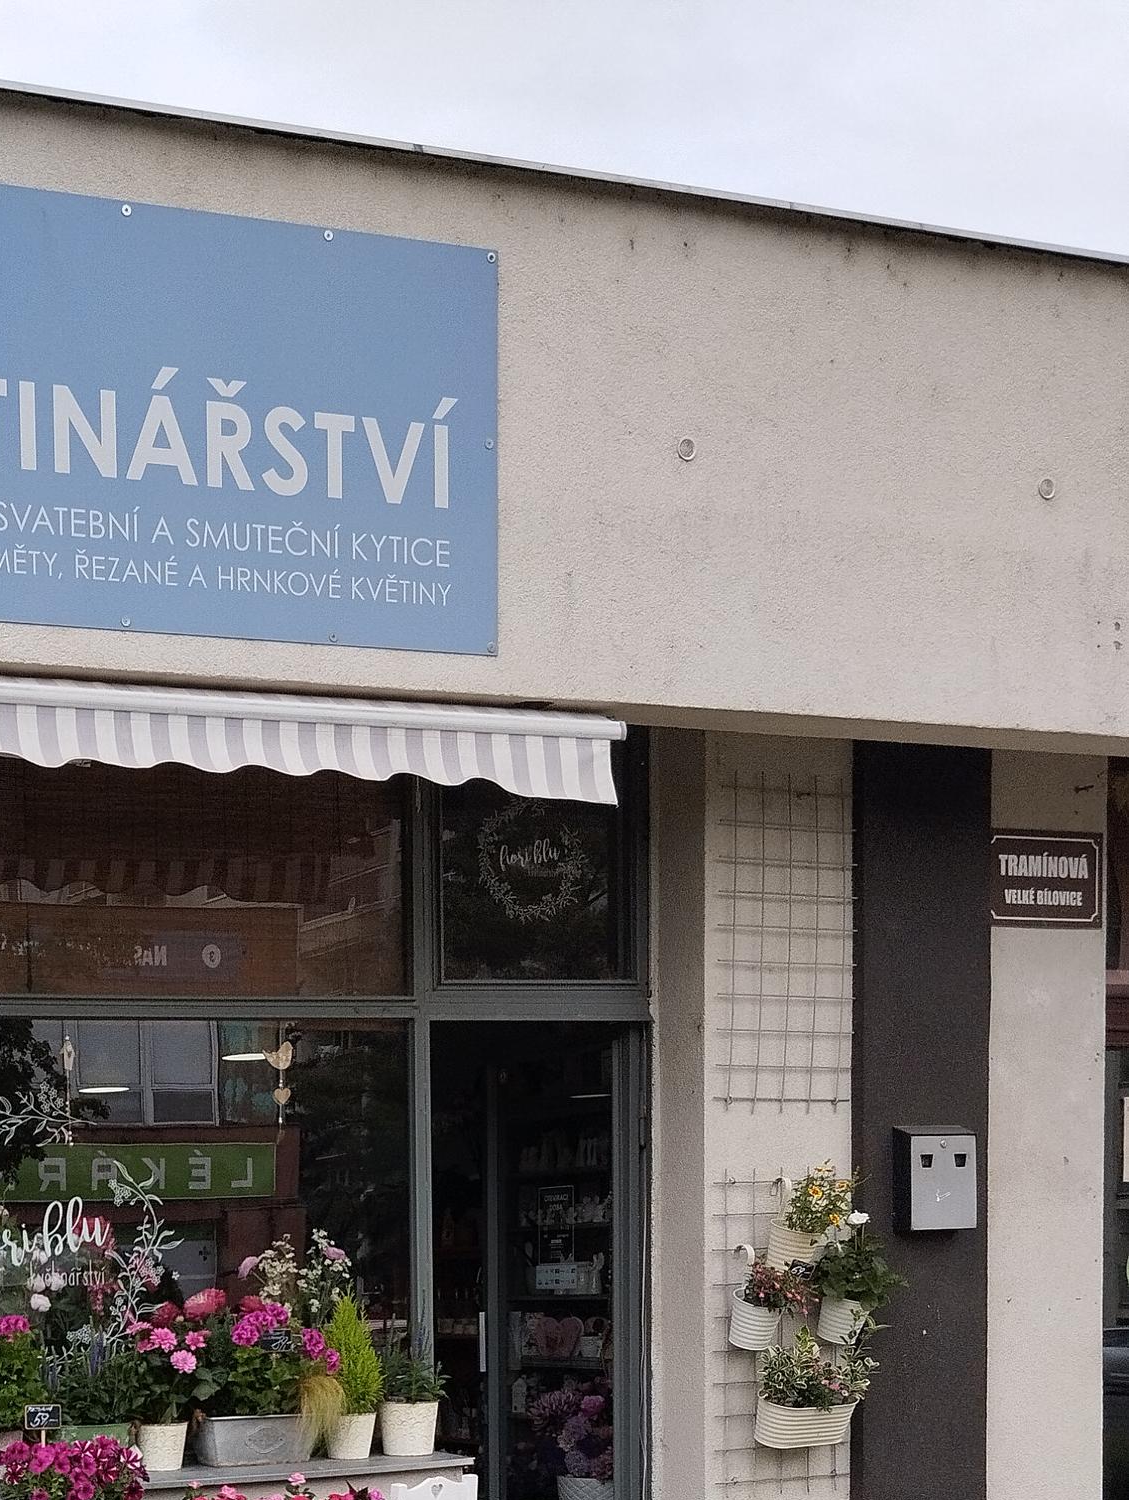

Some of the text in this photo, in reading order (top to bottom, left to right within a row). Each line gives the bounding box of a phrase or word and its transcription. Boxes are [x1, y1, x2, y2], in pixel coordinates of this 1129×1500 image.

[151, 516, 176, 546] A
[185, 517, 342, 560] SMUTEČNÍ
[352, 532, 450, 568] KYTICE
[74, 548, 179, 587] ŘEZANÉ
[188, 563, 208, 589] A
[218, 564, 342, 600] HRNKOVÉ
[351, 573, 452, 607] KVĚTINY
[998, 851, 1089, 880] TRAMÍNOVÁ
[1004, 887, 1083, 907] VELKÉ BÍLOVICE
